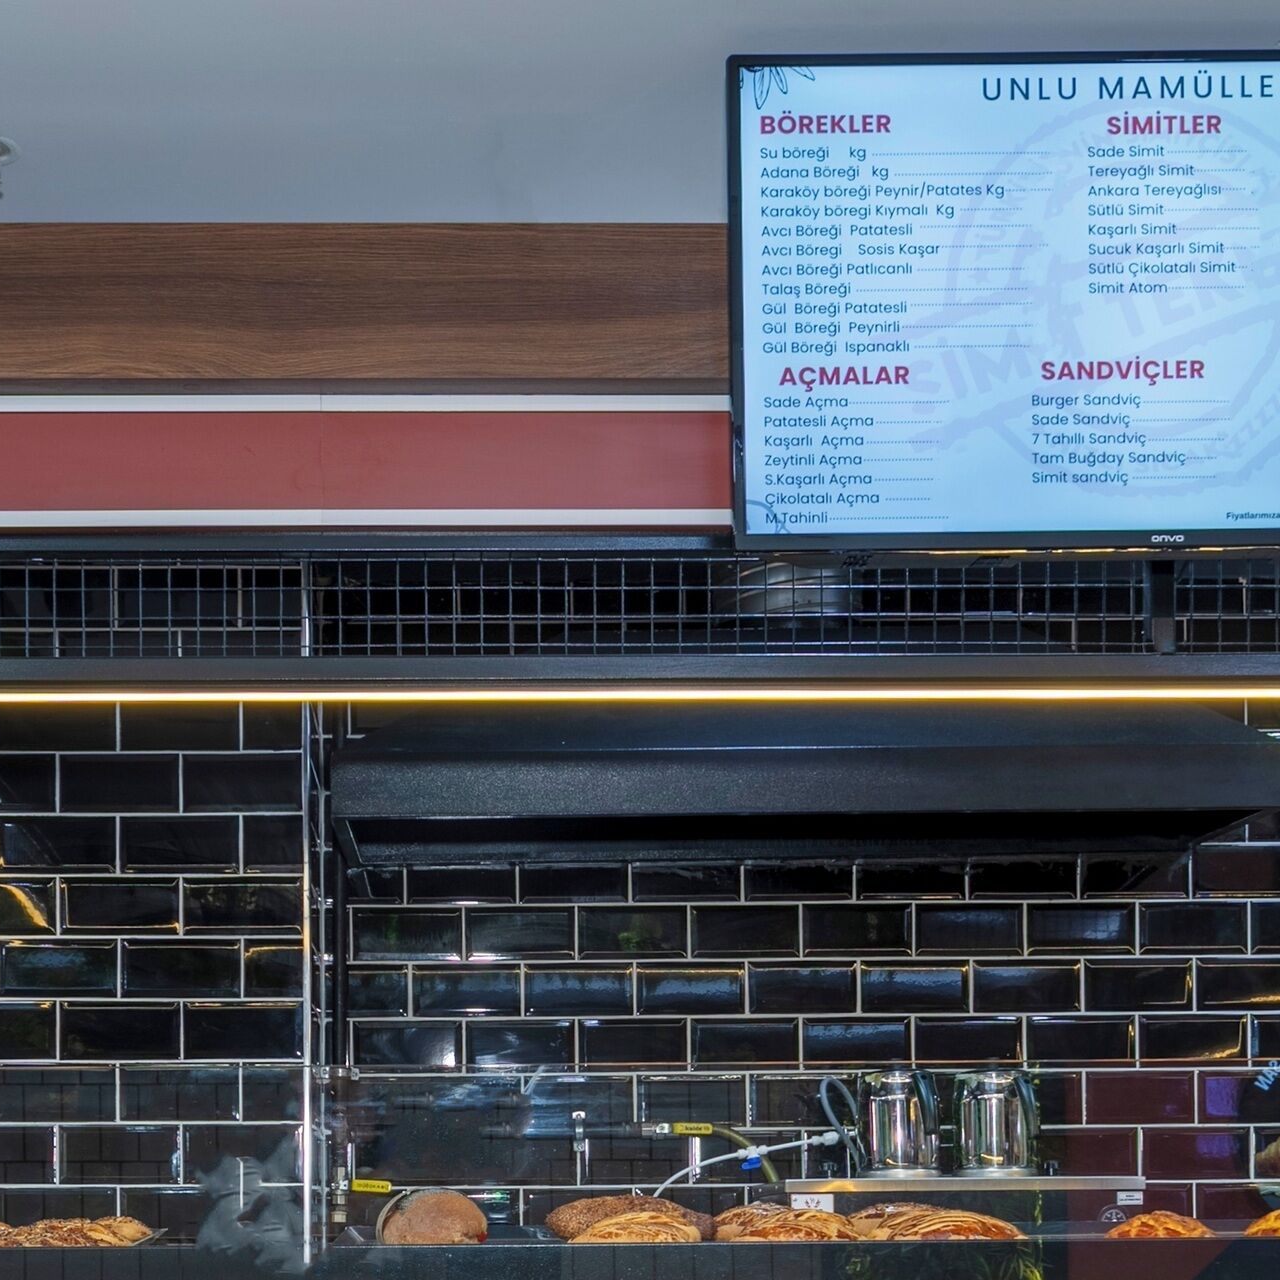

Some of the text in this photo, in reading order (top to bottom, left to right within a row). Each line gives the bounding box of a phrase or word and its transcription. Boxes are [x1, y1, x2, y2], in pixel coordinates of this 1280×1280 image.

[982, 76, 1078, 101] UNLU
[760, 111, 892, 135] BÖREKLER
[1107, 112, 1222, 135] SİMİTLER
[759, 146, 867, 162] Su böreği kg
[1087, 145, 1166, 158] Sade Simit
[760, 165, 890, 181] Adana Böreği kg
[1087, 164, 1195, 180] Tereyağlı Simit
[760, 180, 1005, 201] Karaköy böreği Peynir/Patates Kg
[1087, 183, 1222, 199] Ankara Tereyağlısı
[760, 205, 821, 220] Karaköy
[874, 204, 929, 219] Kıymalı
[936, 204, 955, 219] Kg
[1087, 203, 1165, 216] Sütlü Simit
[761, 223, 914, 240] Avcı Böreği Patatesli
[1087, 223, 1177, 239] Kaşarlı Simit
[761, 245, 792, 256] Avcı
[857, 243, 896, 255] Sosis
[899, 243, 940, 258] Kaşar
[1087, 241, 1225, 258] Sucuk Kaşarlı Simit
[761, 262, 913, 279] Avcı Böreği Patlıcanlı
[1087, 261, 1236, 278] Sütlü Çikolatalı Simit
[761, 282, 852, 298] Talaş Böreği
[1087, 282, 1169, 294] Simit Atom
[761, 301, 908, 318] Gül Böreği Patatesli
[761, 321, 901, 338] Gül Böreği Peynirli
[762, 340, 911, 356] Gül Böreği Ispanaklı
[778, 365, 911, 392] AÇMALAR
[1040, 355, 1205, 386] SANDVİÇLER
[763, 396, 849, 412] Sade Açma
[1031, 392, 1142, 409] Burger Sandviç
[763, 415, 875, 430] Patatesli Açma
[1031, 413, 1131, 428] Sade Sandviç
[763, 434, 865, 451] Kaşarlı Açma
[1031, 433, 1040, 444] 7
[1088, 432, 1147, 449] Sandviç
[764, 454, 863, 469] Zeytinli Açma
[1031, 450, 1187, 467] Tam Buğday Sandviç
[764, 473, 873, 489] S.Kaşarlı Açma
[1031, 470, 1130, 487] Simit sandviç
[764, 492, 880, 510] Çikolatalı Açma
[764, 511, 829, 524] M.Tahinli
[1151, 534, 1185, 543] onvo
